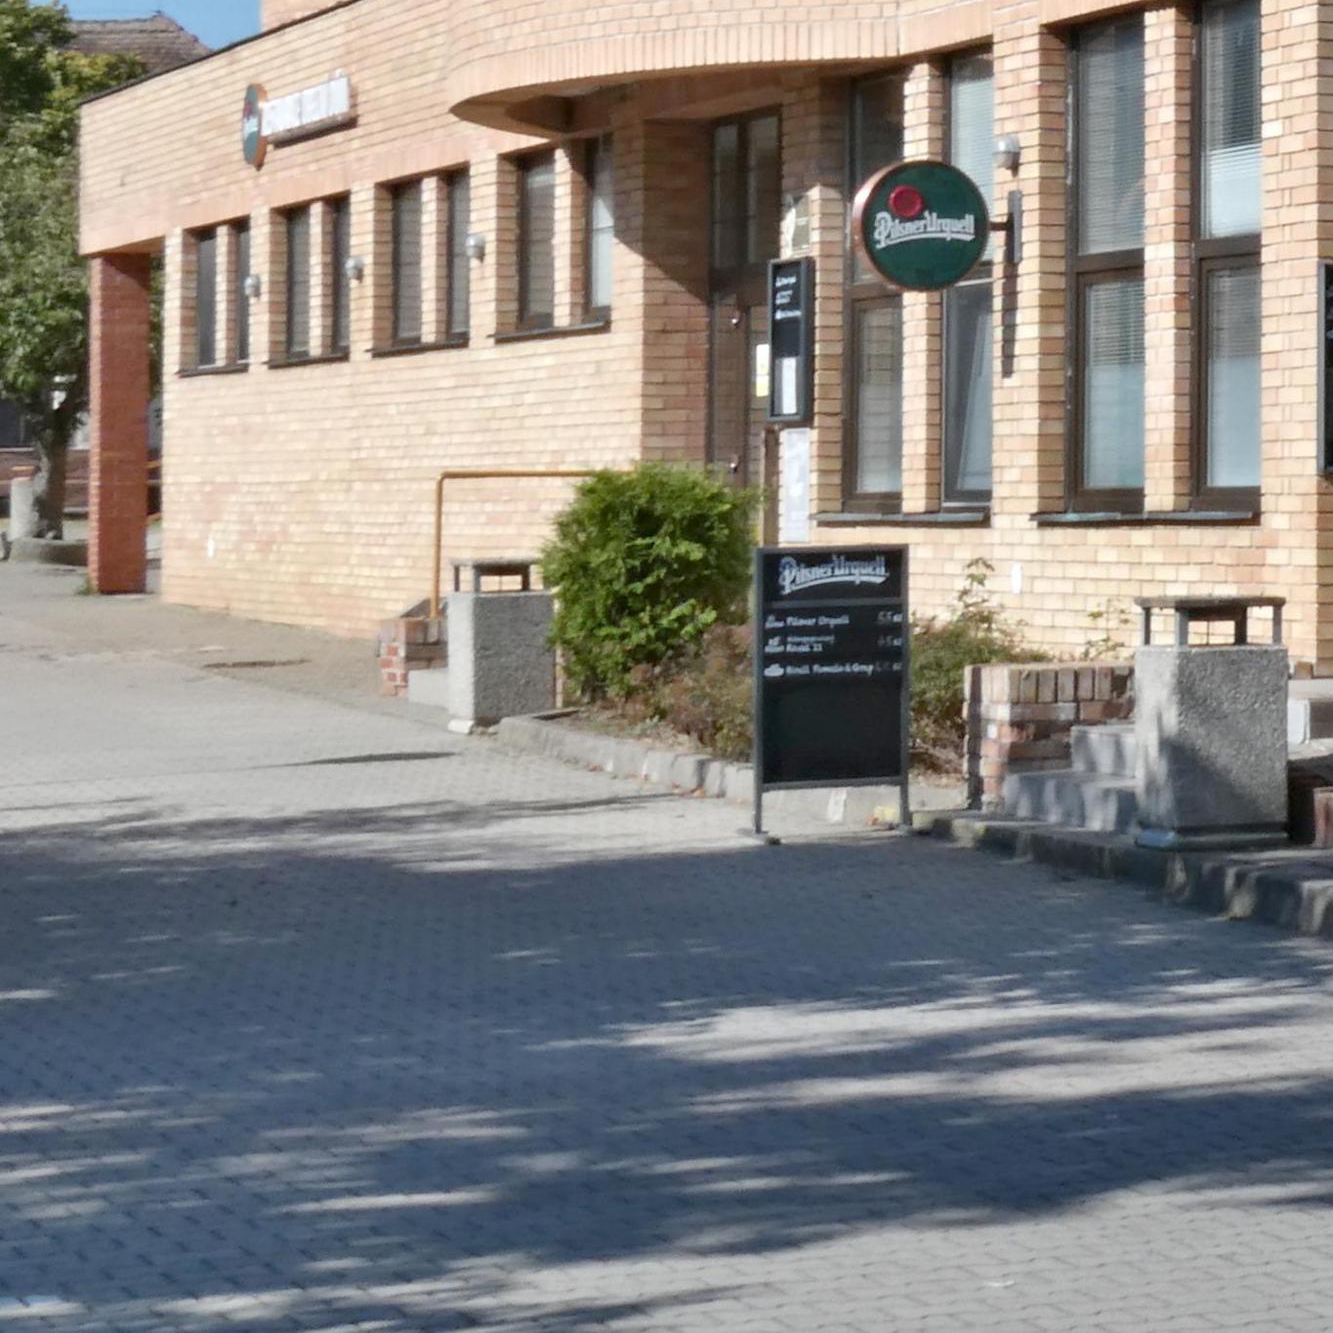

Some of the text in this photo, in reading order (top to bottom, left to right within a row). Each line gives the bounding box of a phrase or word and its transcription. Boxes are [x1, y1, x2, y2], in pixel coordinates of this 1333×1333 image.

[873, 210, 976, 249] Pilsner Urquell
[778, 554, 889, 595] Pilsner Urquell
